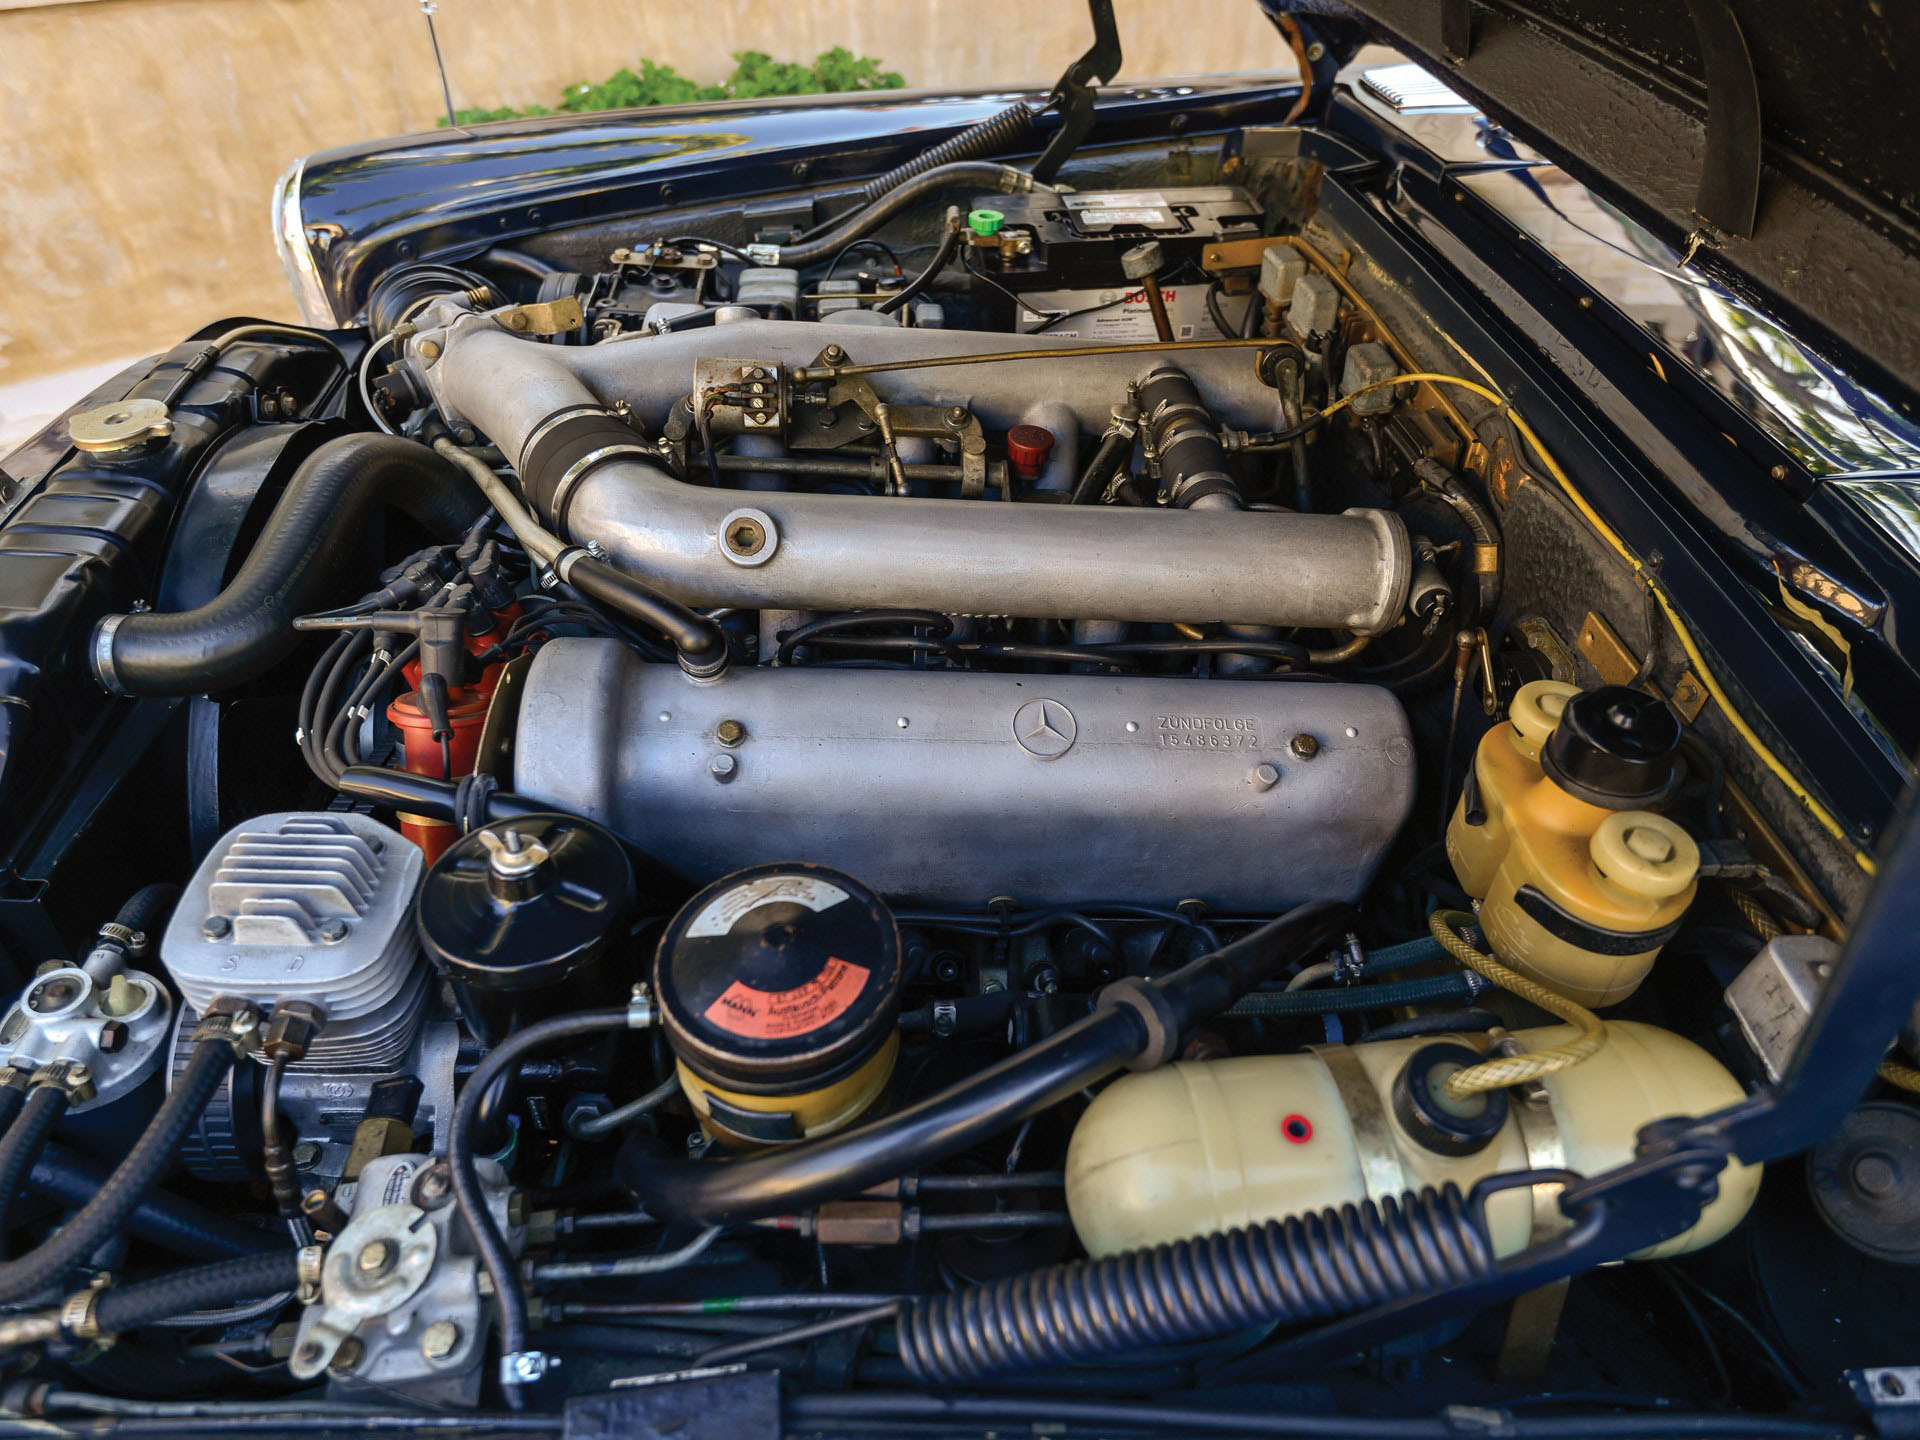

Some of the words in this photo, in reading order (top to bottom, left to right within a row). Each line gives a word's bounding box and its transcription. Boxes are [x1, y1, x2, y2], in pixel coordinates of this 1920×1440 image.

[1124, 290, 1176, 305] BOH
[1157, 715, 1256, 731] ZÜNDFOLGE
[1159, 734, 1258, 748] 15486372
